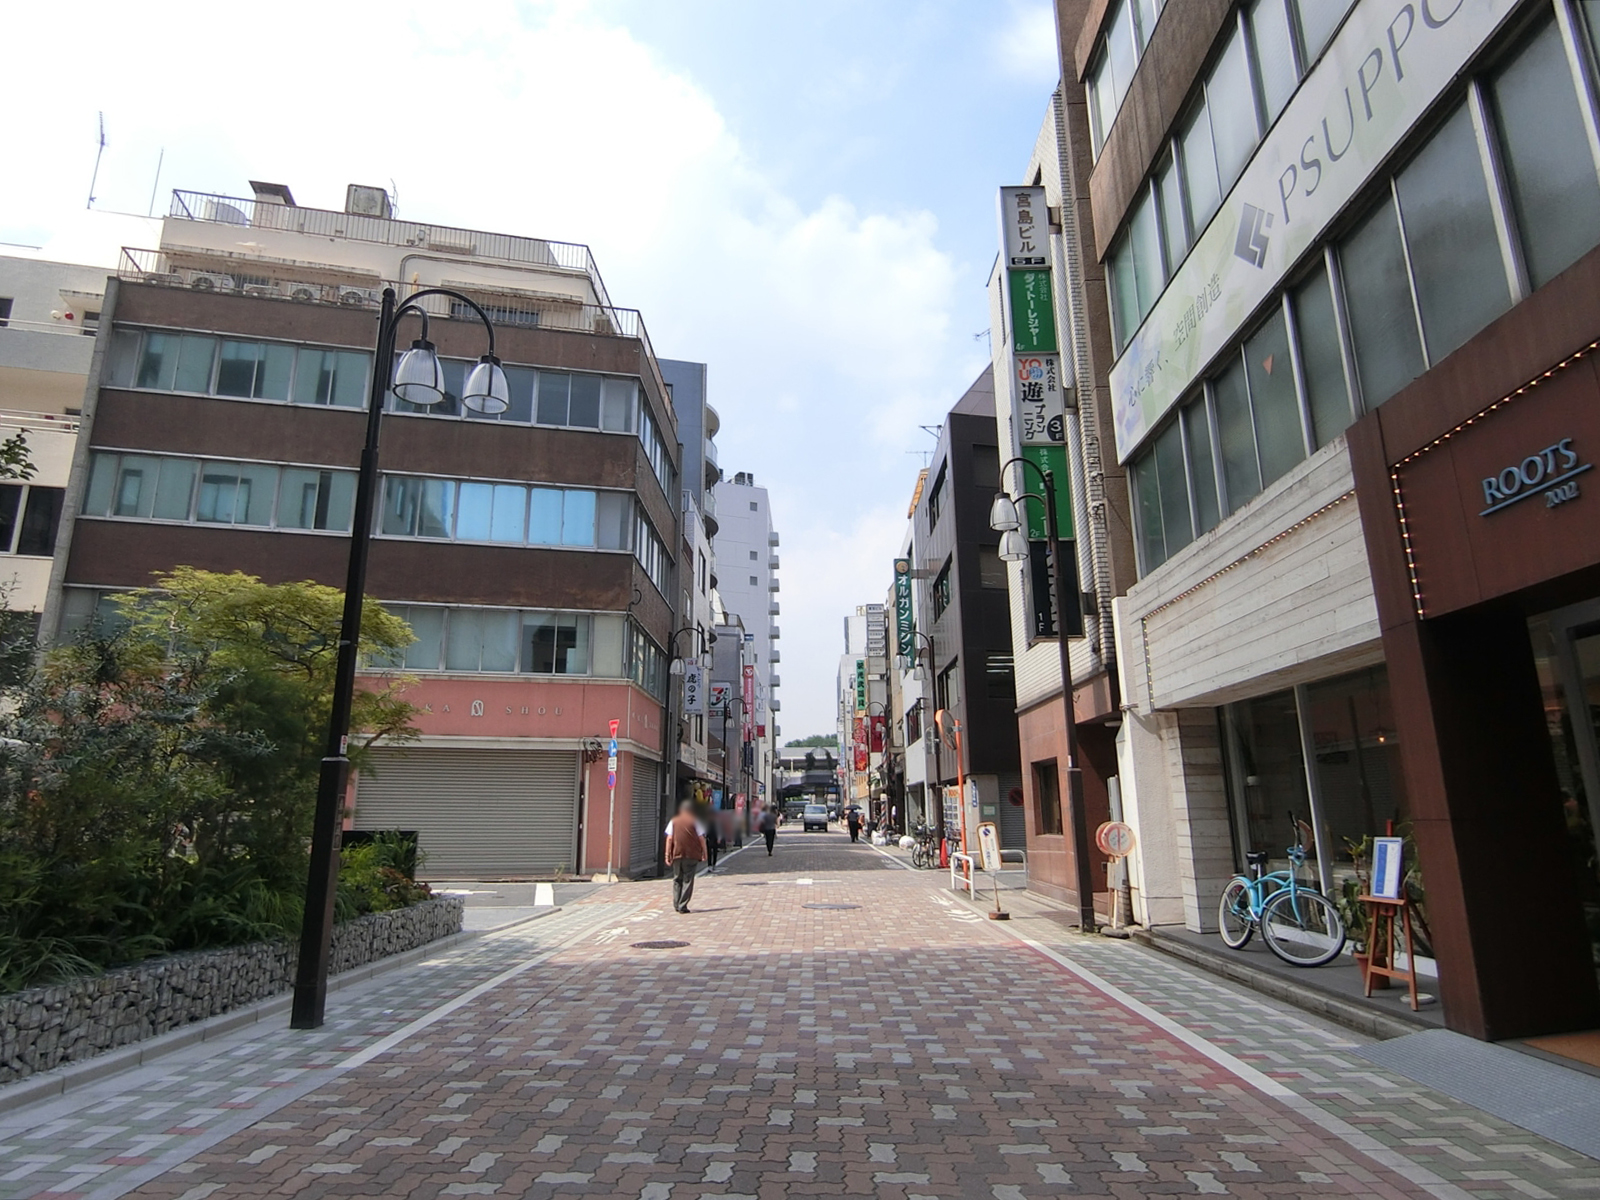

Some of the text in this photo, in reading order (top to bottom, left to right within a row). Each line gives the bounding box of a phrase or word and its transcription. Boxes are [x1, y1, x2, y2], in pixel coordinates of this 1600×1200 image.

[1015, 192, 1036, 253] 宮島ビル
[1046, 358, 1057, 392] 株式会社
[1482, 437, 1578, 505] ROOTS
[687, 673, 697, 705] 虎の子
[505, 705, 564, 715] SHOU
